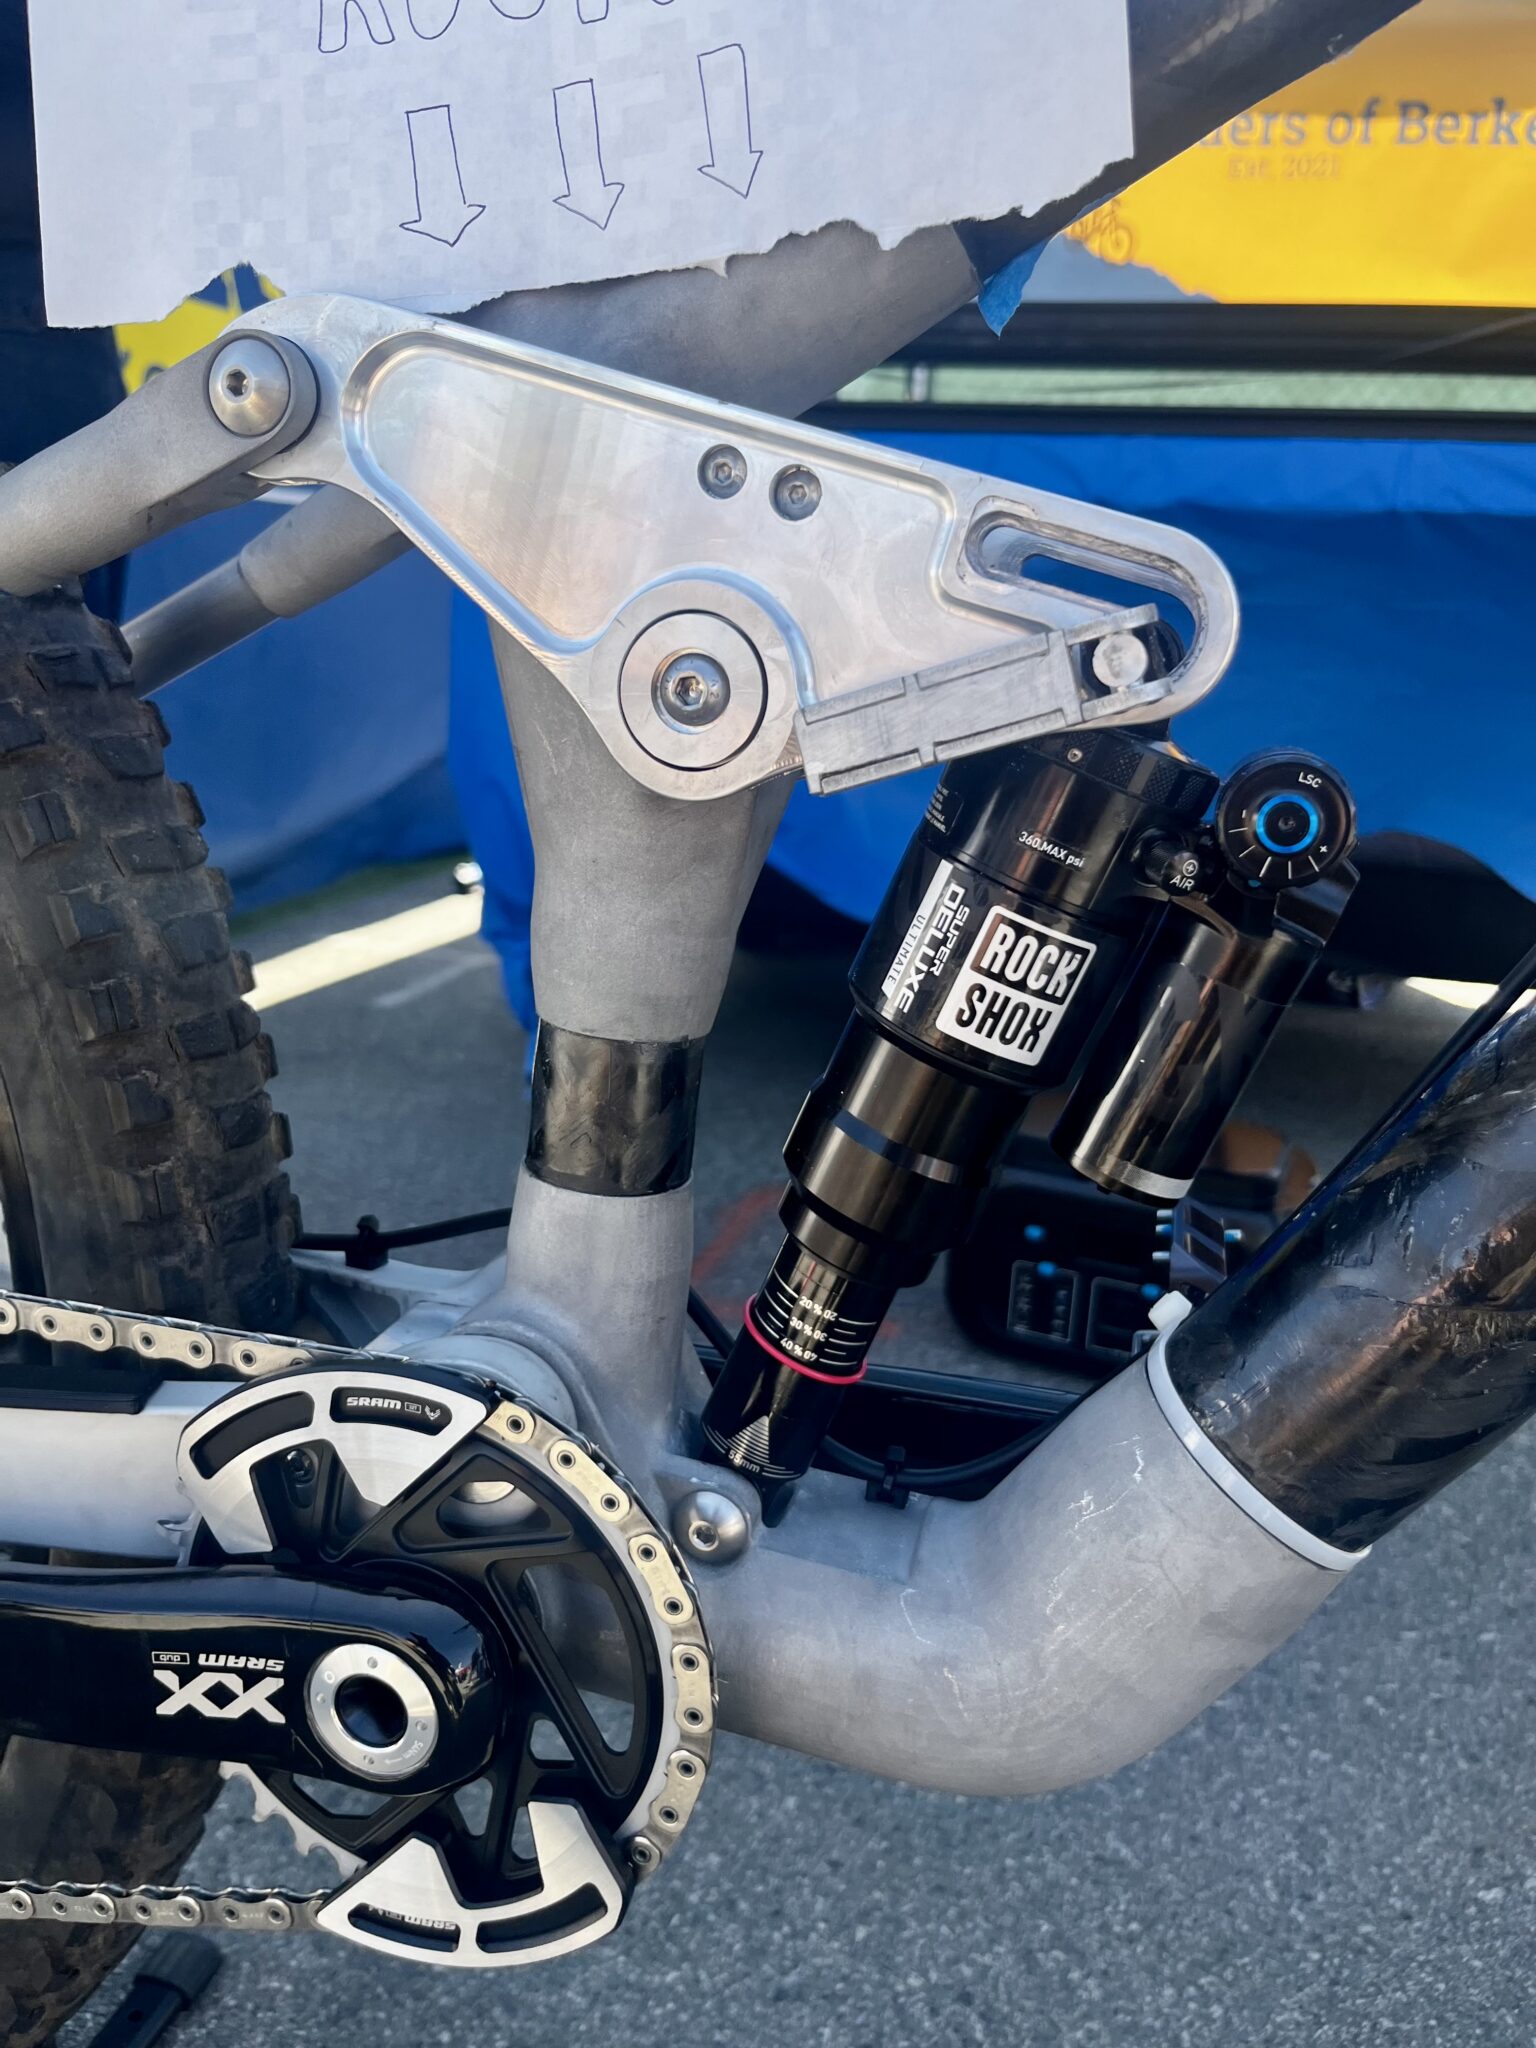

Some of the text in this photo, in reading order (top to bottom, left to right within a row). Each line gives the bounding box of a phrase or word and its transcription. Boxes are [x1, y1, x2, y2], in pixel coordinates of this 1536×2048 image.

[1327, 97, 1382, 146] of
[1298, 771, 1322, 788] LSC
[1066, 854, 1086, 868] psi
[1169, 875, 1195, 891] AIR
[886, 914, 926, 986] ULTIMATE
[894, 882, 966, 1014] DELUXE
[929, 904, 970, 977] SUPER
[979, 922, 1084, 998] ROCK
[955, 983, 1053, 1053] SHOX
[346, 1396, 402, 1410] SRAM
[728, 1449, 761, 1472] 55mm
[198, 1653, 286, 1672] SRAM
